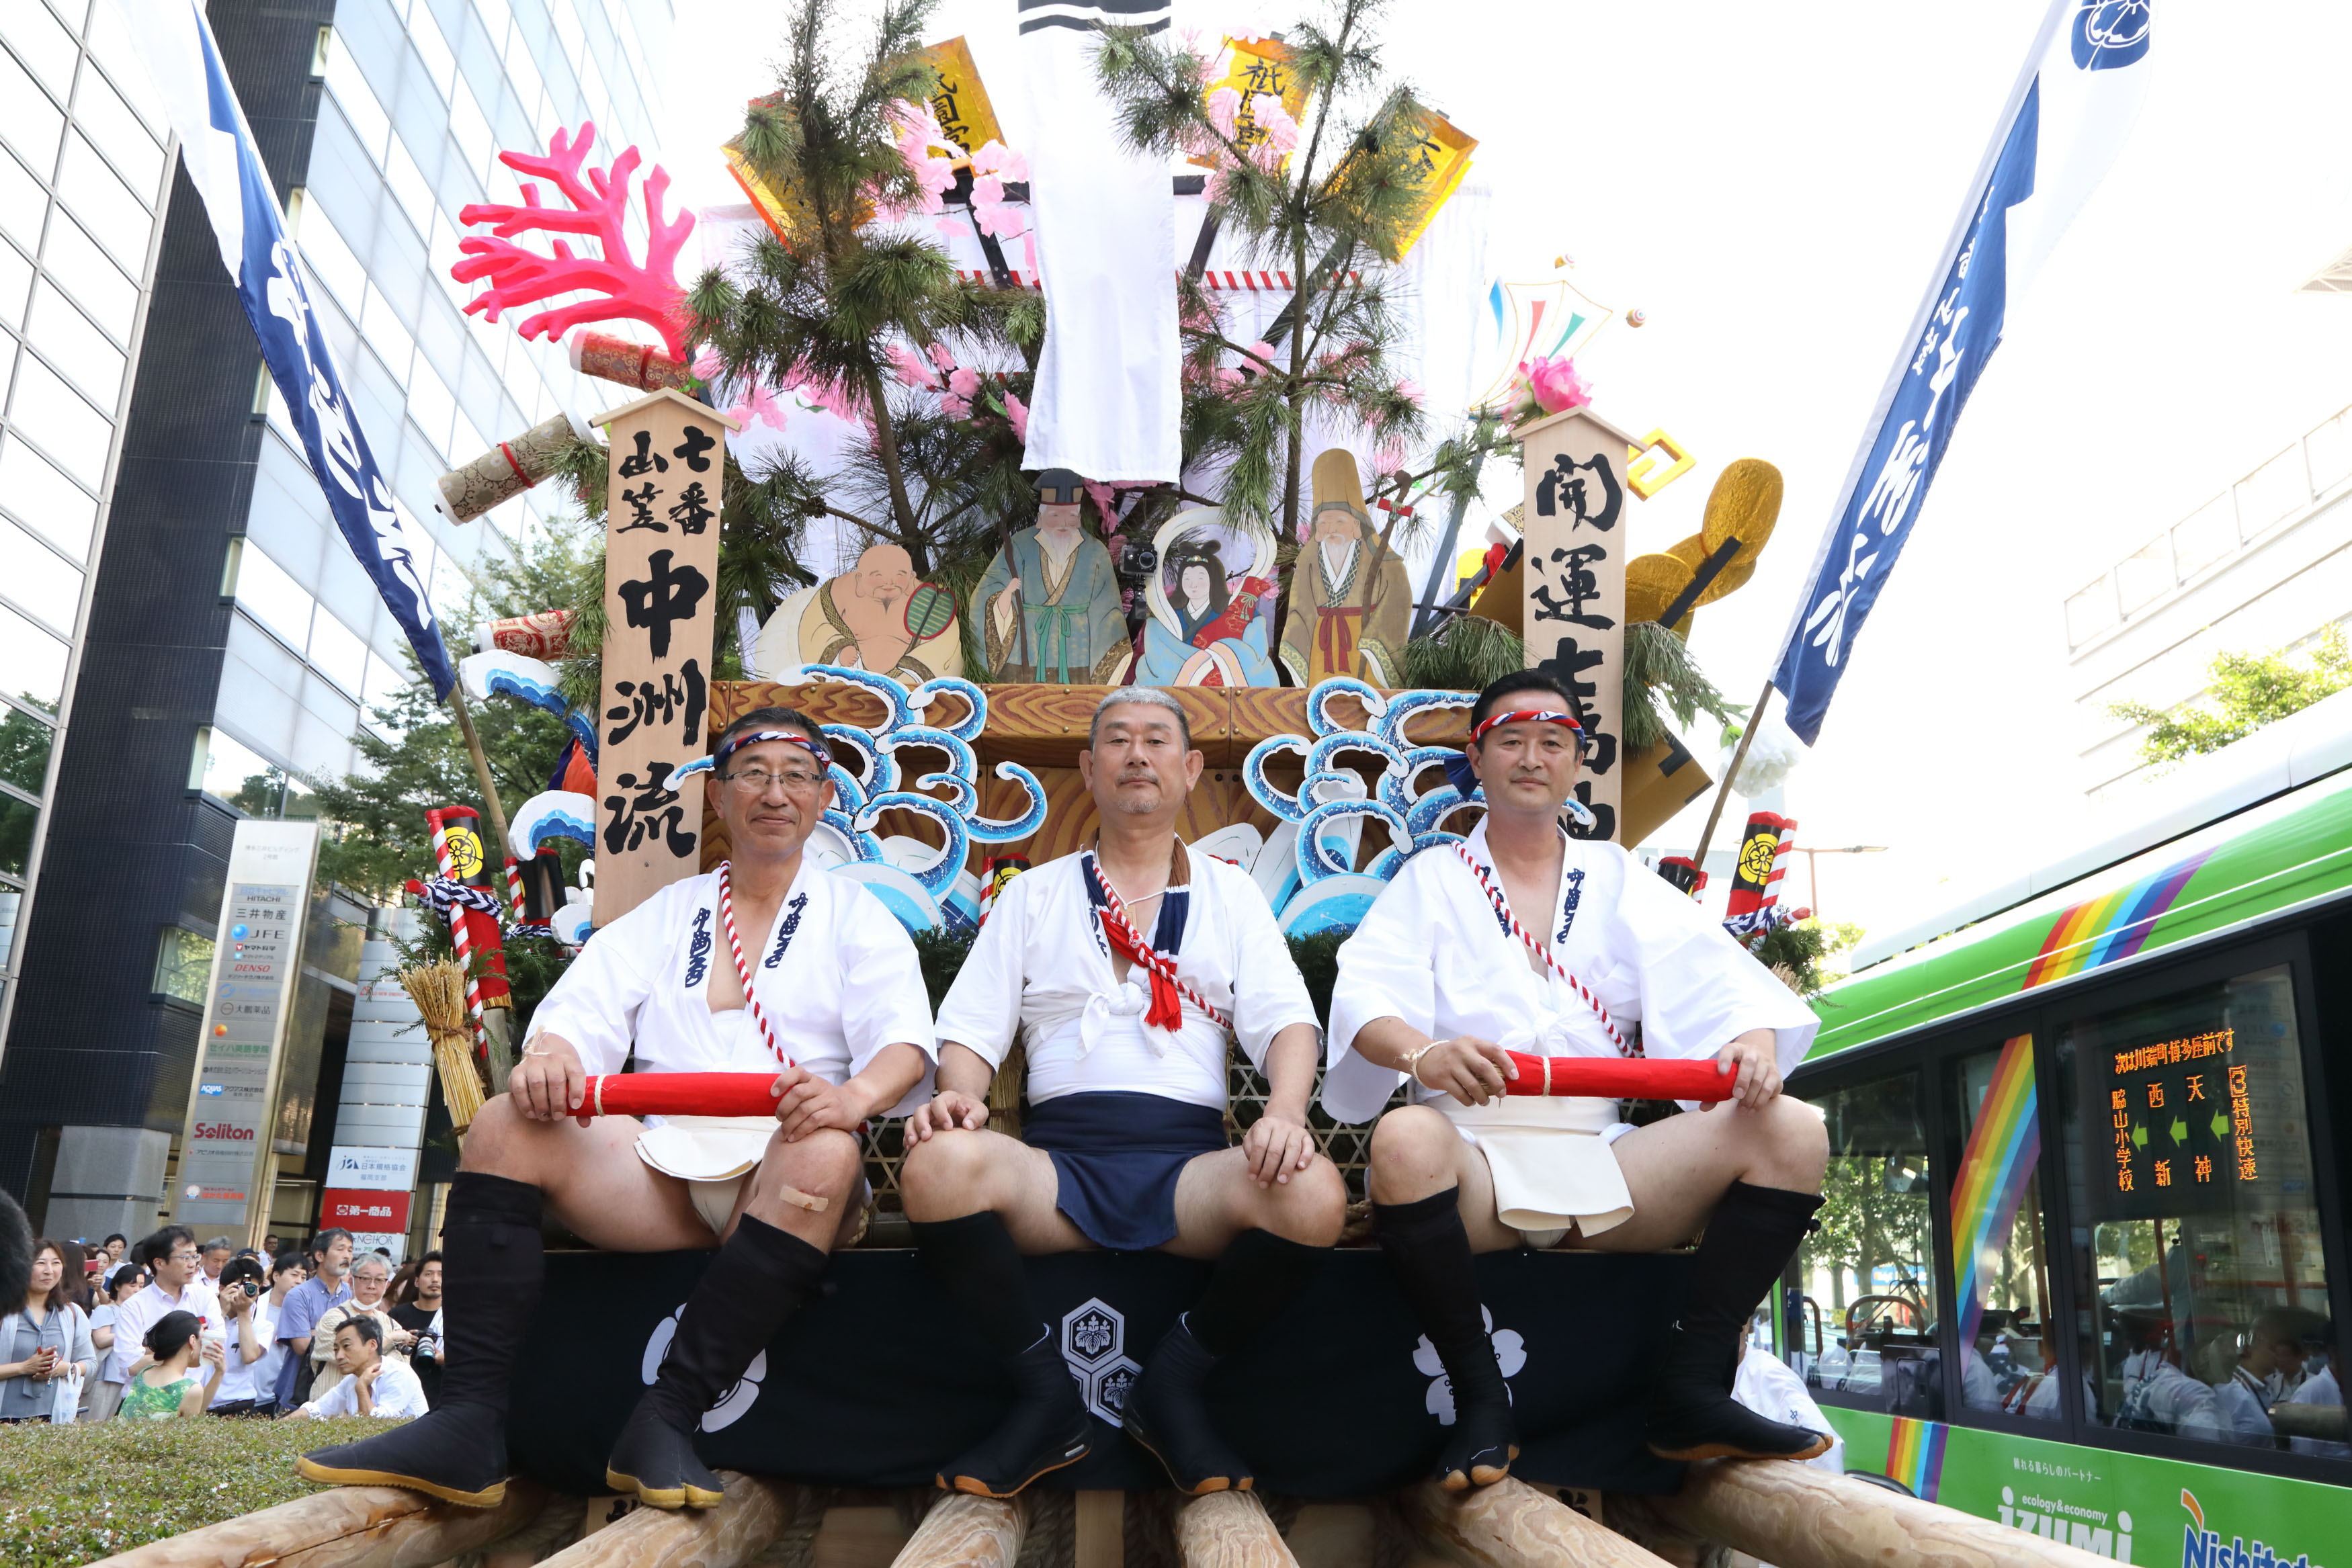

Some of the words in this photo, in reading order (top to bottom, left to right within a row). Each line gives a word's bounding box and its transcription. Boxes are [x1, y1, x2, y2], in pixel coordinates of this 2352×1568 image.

[603, 549, 709, 859] 中洲流
[236, 908, 287, 920] 三井物産
[249, 929, 285, 940] JFE
[235, 964, 271, 972] DENSO
[200, 1084, 222, 1092] AQUAS
[194, 1123, 254, 1140] Soliton
[361, 1162, 407, 1172] 日本規格協会
[349, 1205, 392, 1217] 第一商品
[2021, 1493, 2108, 1526] ecology&economy
